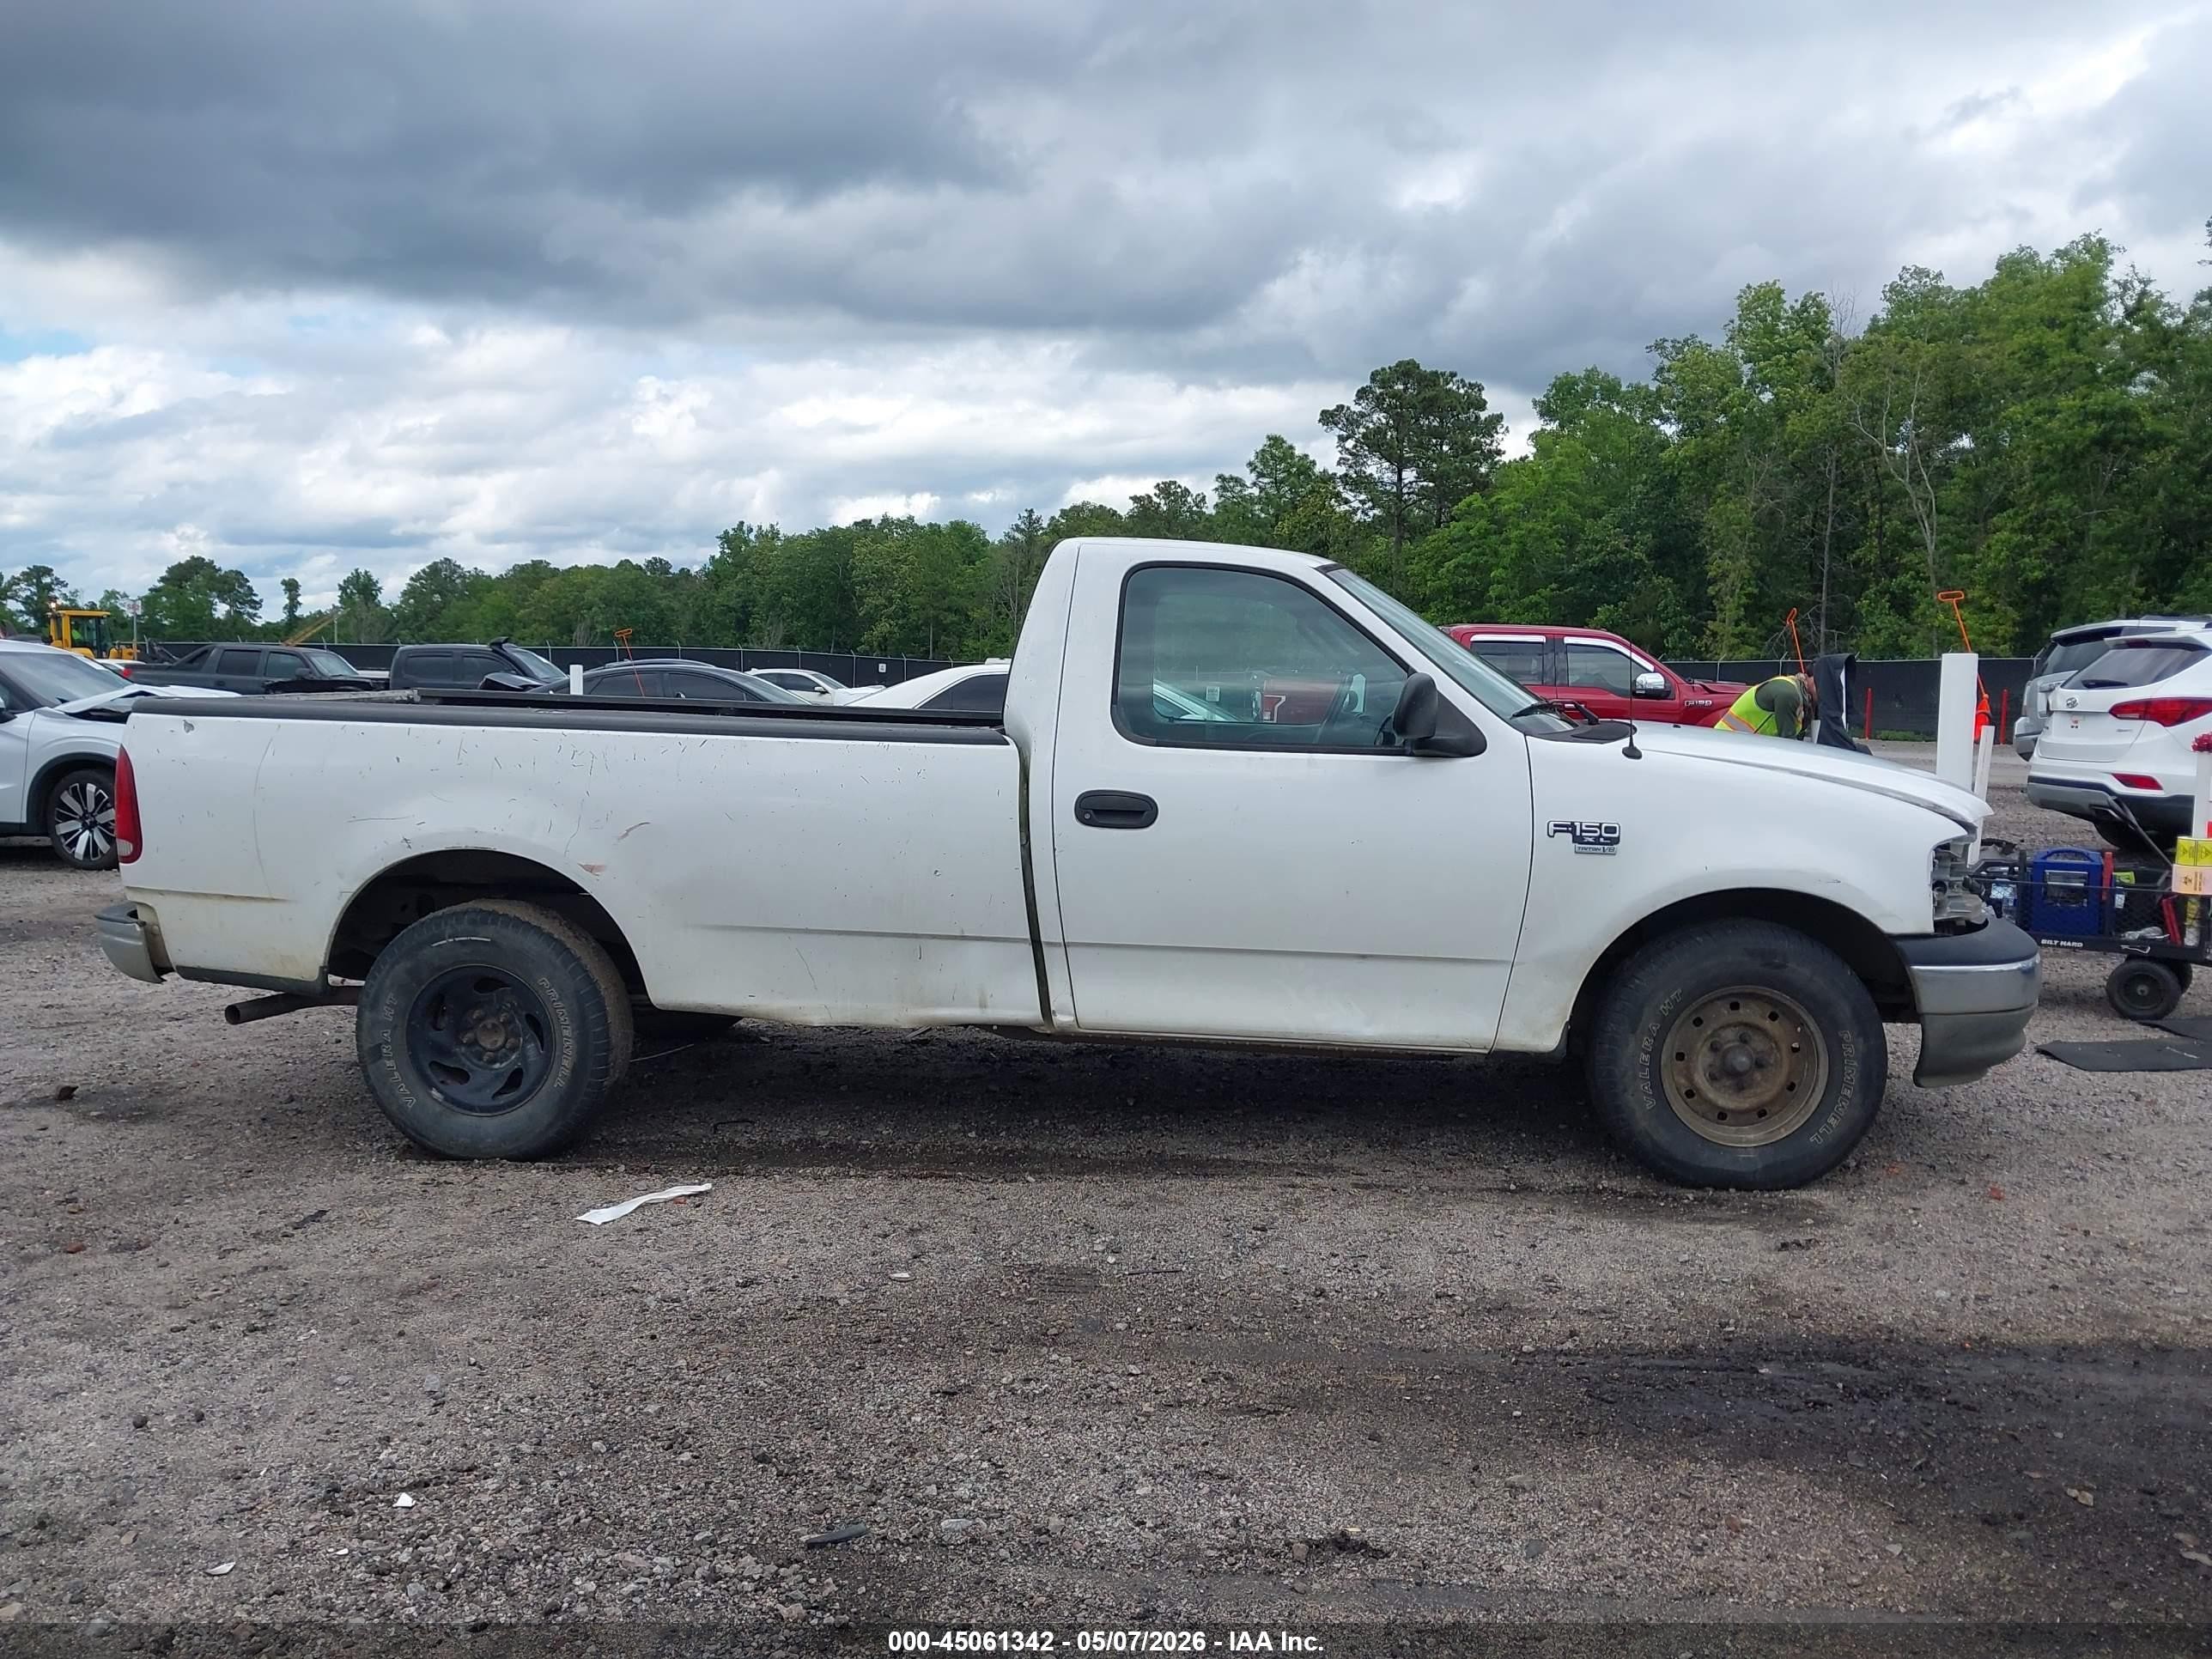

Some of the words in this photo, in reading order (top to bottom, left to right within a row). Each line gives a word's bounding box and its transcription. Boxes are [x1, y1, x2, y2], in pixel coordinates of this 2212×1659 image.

[383, 992, 398, 1022] HT
[538, 977, 573, 1088] PRIMEWELL
[1638, 1023, 1662, 1110] VALERA
[1659, 988, 1683, 1017] HT
[380, 1030, 416, 1109] VALERA
[1809, 1030, 1858, 1145] PRIMEWELL
